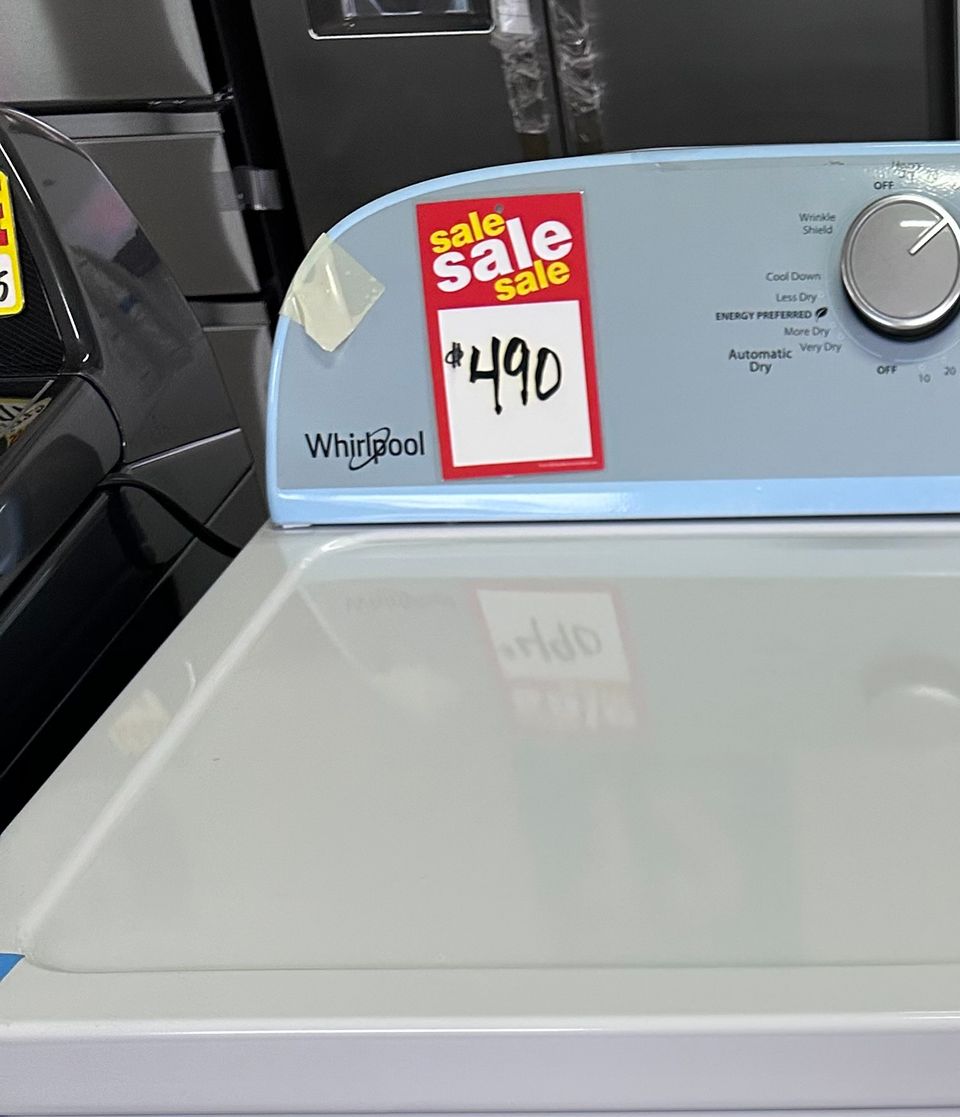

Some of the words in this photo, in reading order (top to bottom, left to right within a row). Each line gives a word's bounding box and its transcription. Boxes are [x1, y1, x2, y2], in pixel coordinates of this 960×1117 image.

[873, 181, 895, 191] OFF
[799, 212, 836, 222] Wrinkle
[430, 211, 506, 254] sale
[802, 225, 833, 235] Shield
[432, 217, 573, 293] sale
[494, 259, 571, 301] sale
[765, 271, 790, 281] Cool
[791, 271, 822, 281] Down
[776, 293, 798, 302] Less
[799, 292, 818, 304] Dry
[715, 311, 754, 321] ENERGY
[756, 310, 813, 320] PREFERRED
[784, 327, 810, 336] More
[812, 326, 831, 338] Dry
[728, 347, 793, 361] Automatic
[799, 342, 822, 354] Very
[823, 342, 842, 354] Dry
[749, 361, 772, 375] Dry
[876, 365, 898, 375] OFF
[943, 366, 957, 376] 20
[445, 336, 563, 416] $490
[918, 374, 931, 383] 10
[304, 427, 425, 470] Whirlpool
